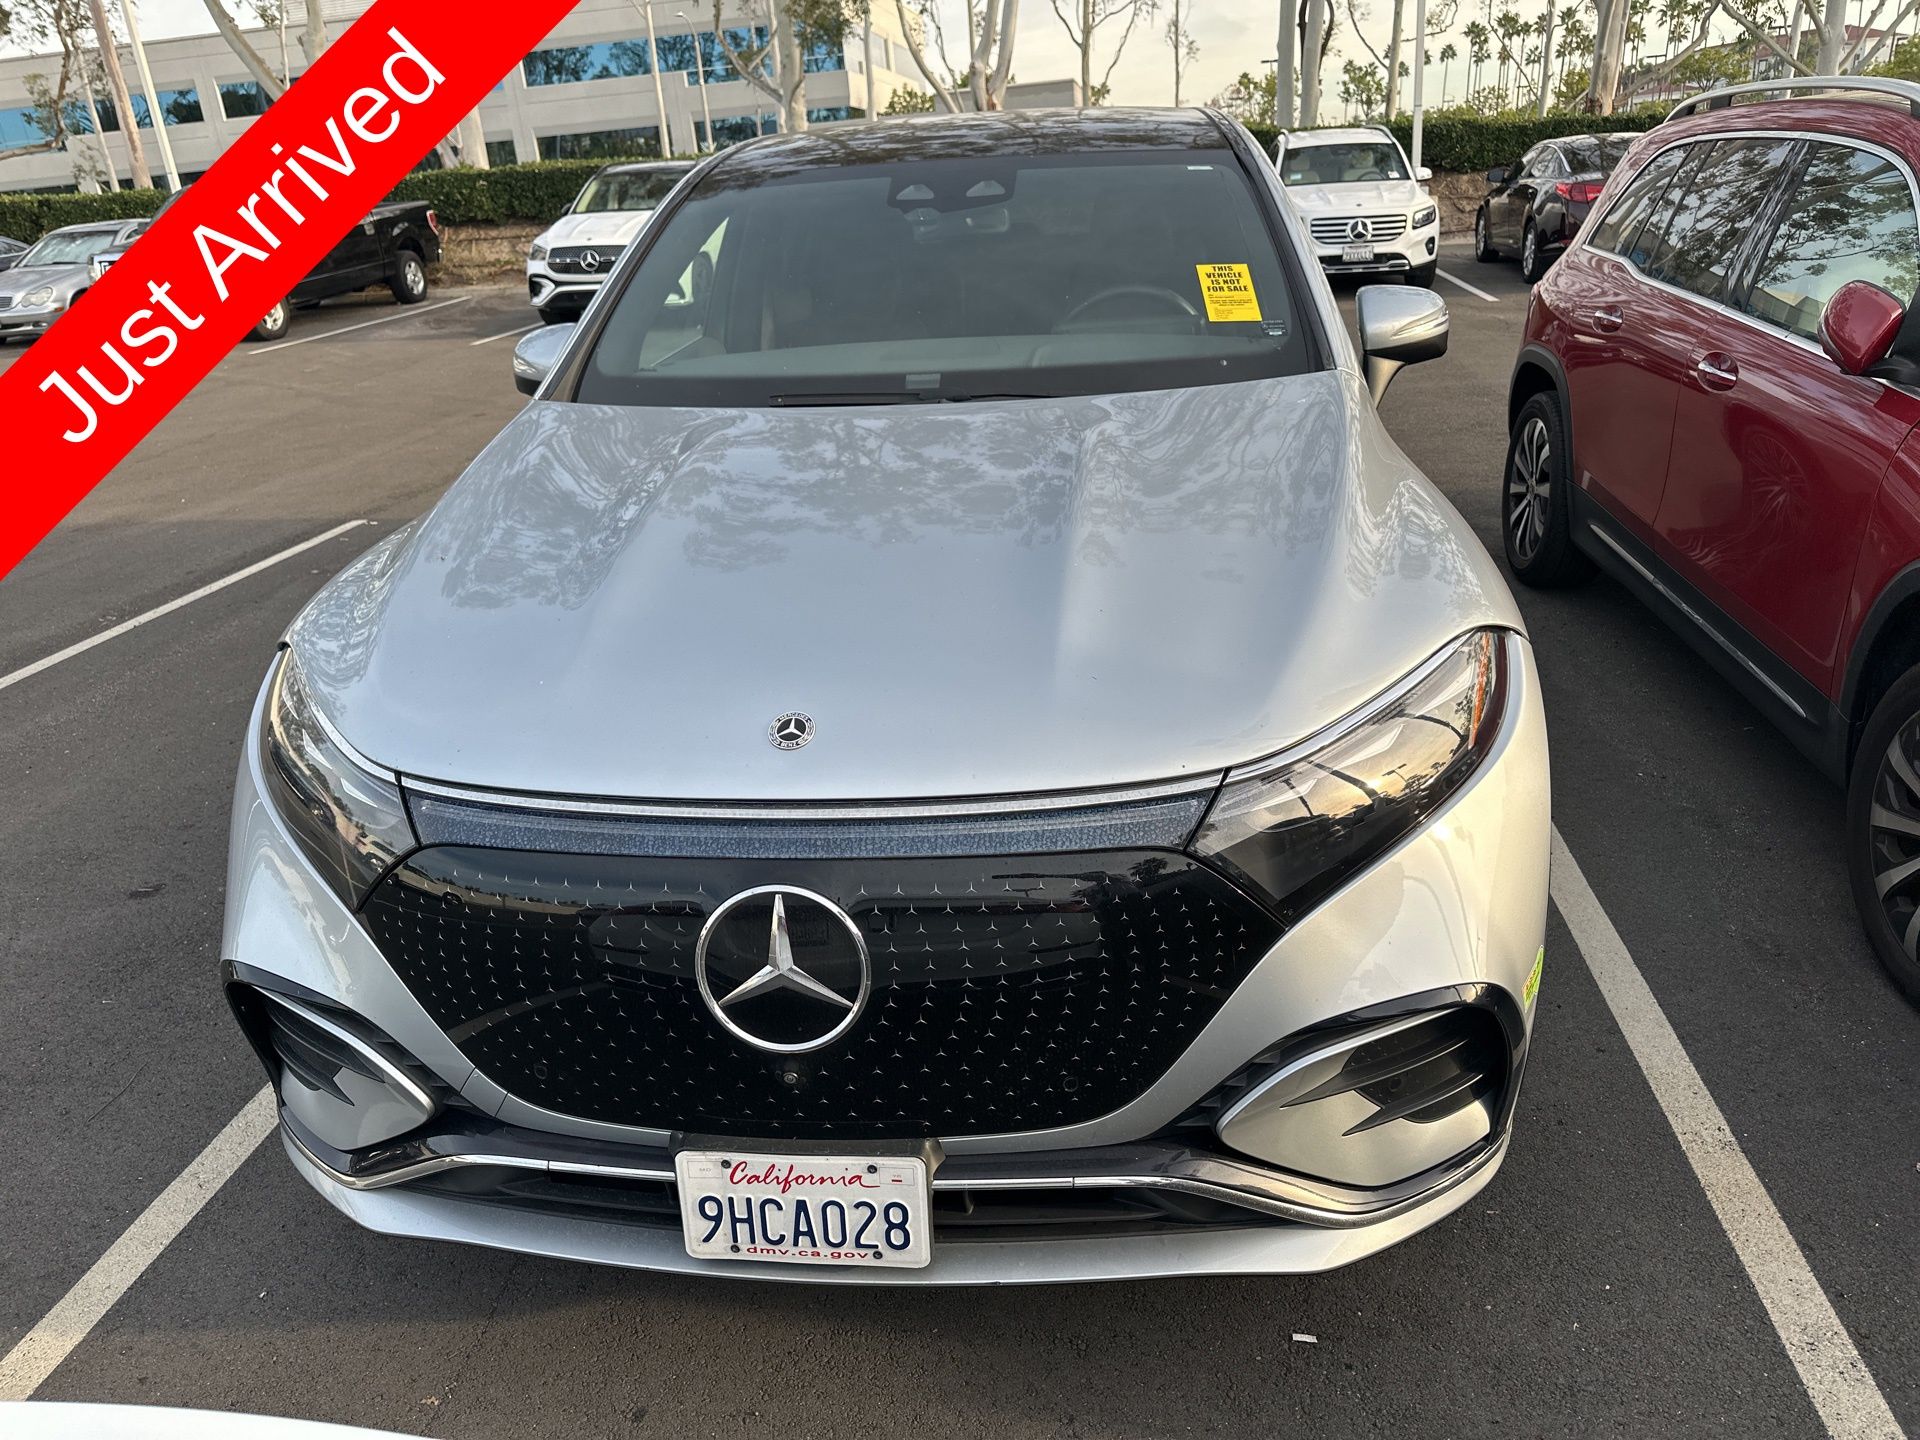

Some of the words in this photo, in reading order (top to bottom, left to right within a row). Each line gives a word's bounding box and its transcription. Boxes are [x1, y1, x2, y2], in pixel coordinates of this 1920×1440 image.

[729, 1161, 880, 1193] California
[698, 1196, 911, 1250] 9HCA028
[746, 1246, 869, 1260] dmv.ca.gov
